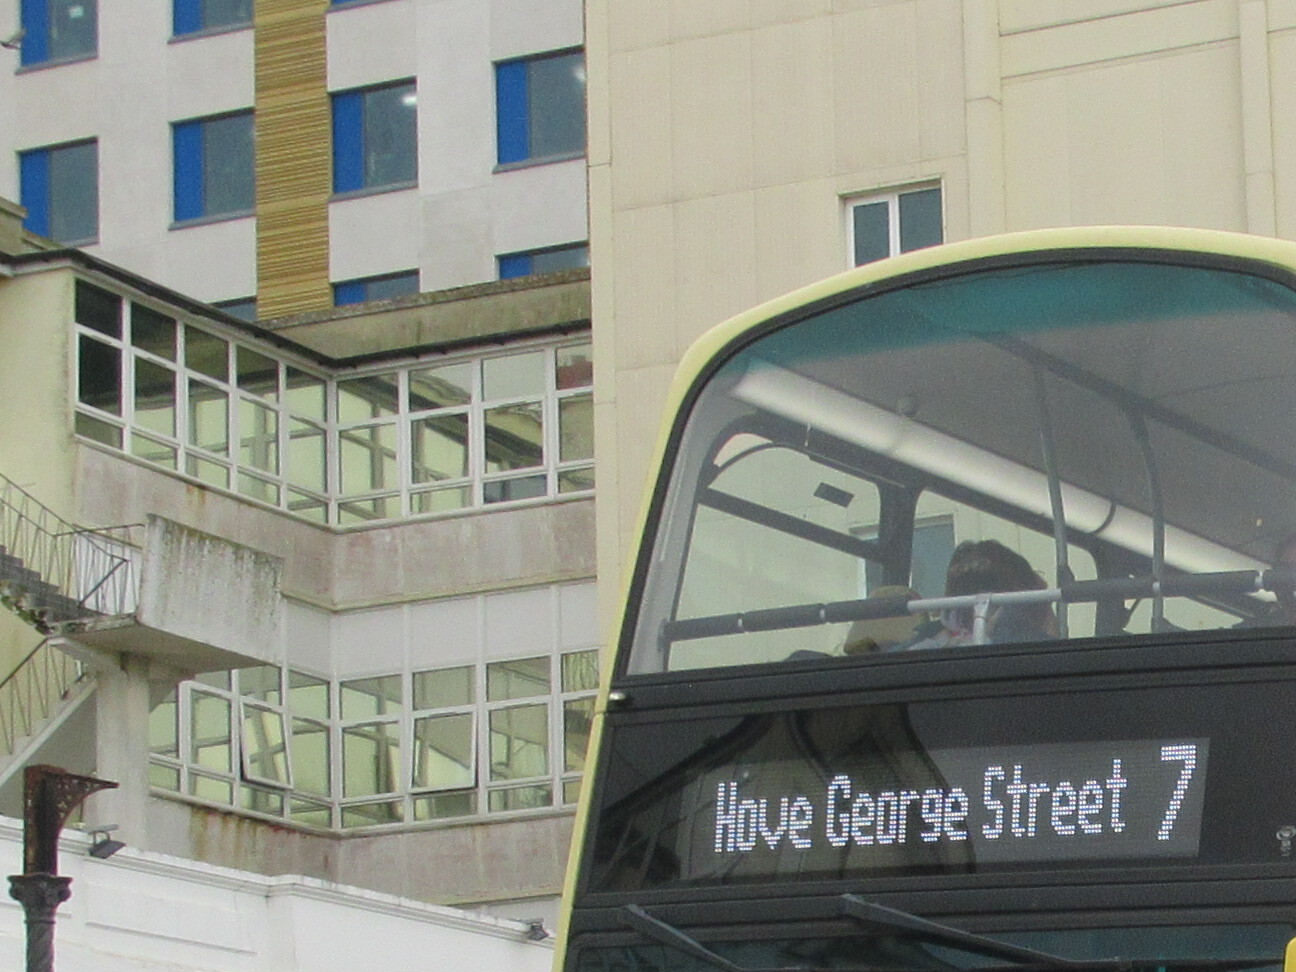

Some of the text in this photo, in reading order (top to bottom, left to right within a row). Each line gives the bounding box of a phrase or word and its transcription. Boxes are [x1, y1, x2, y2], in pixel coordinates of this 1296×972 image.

[714, 744, 1198, 853] Hove George Street 7
